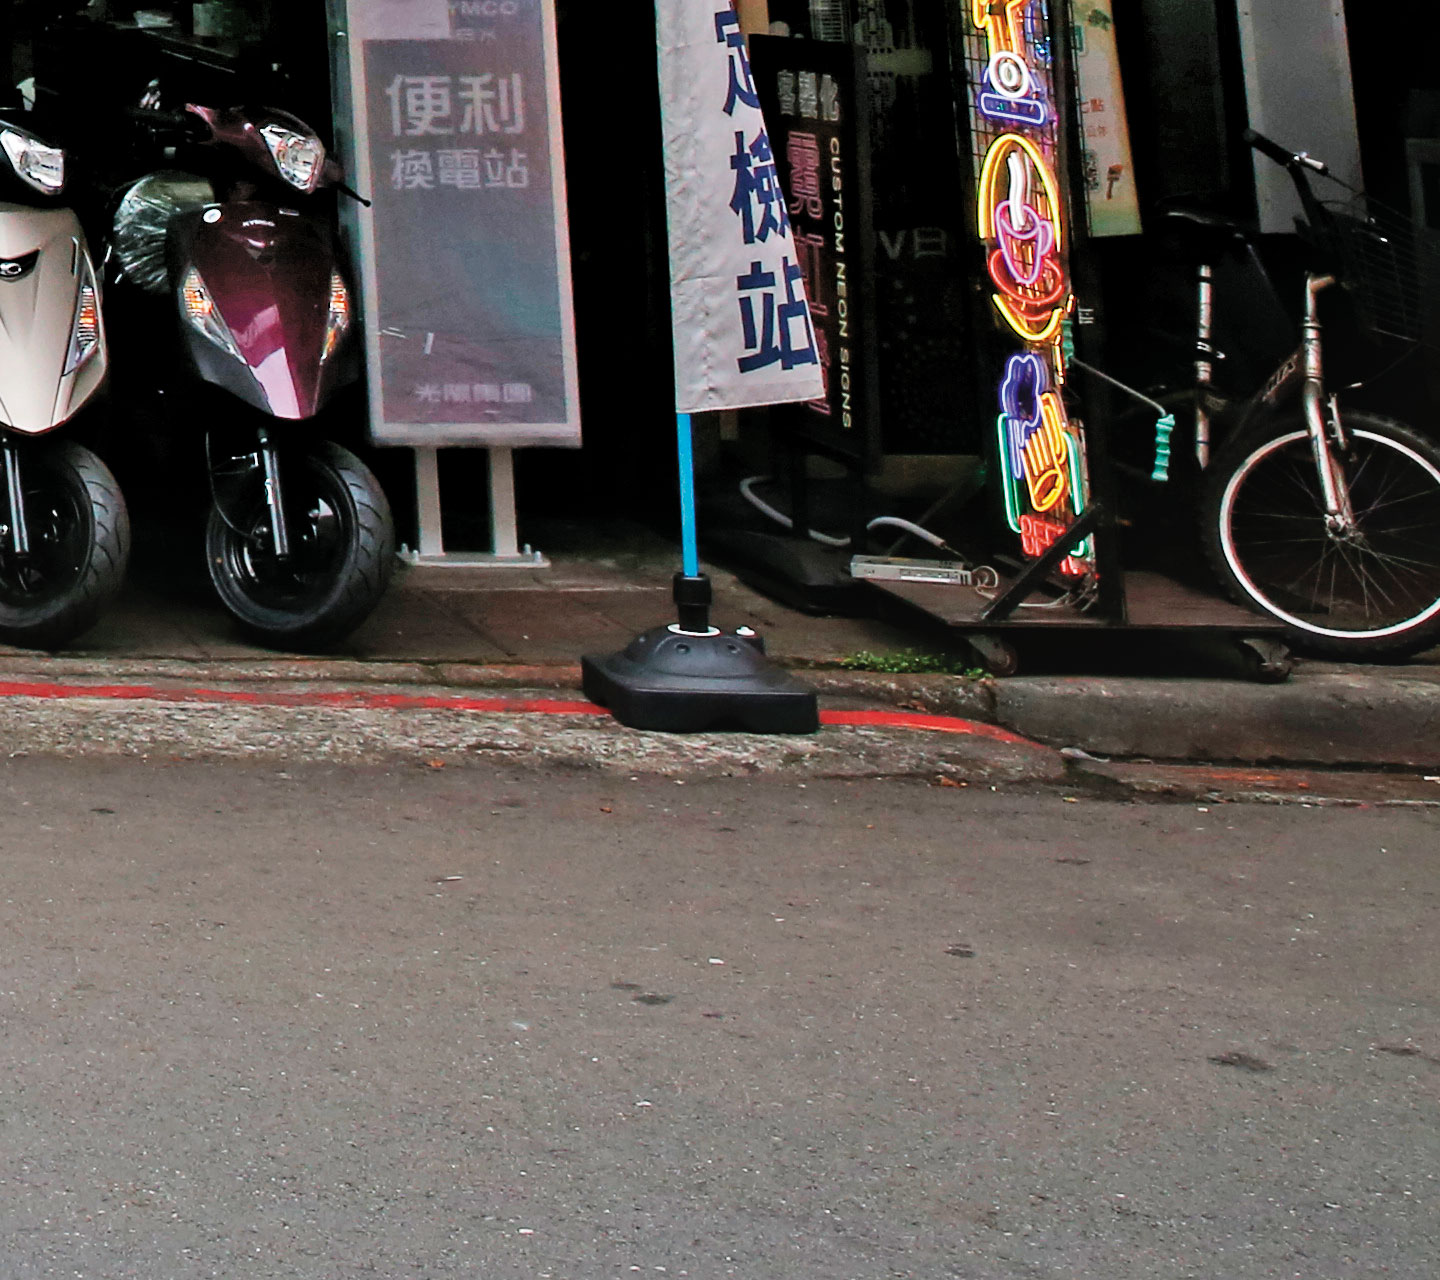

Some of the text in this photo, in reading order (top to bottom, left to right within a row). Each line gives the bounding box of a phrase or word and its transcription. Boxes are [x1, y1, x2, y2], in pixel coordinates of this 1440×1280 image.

[385, 73, 527, 137] 便利
[390, 148, 529, 190] 換電站
[830, 137, 852, 429] CUSTOM NEON SIGNS
